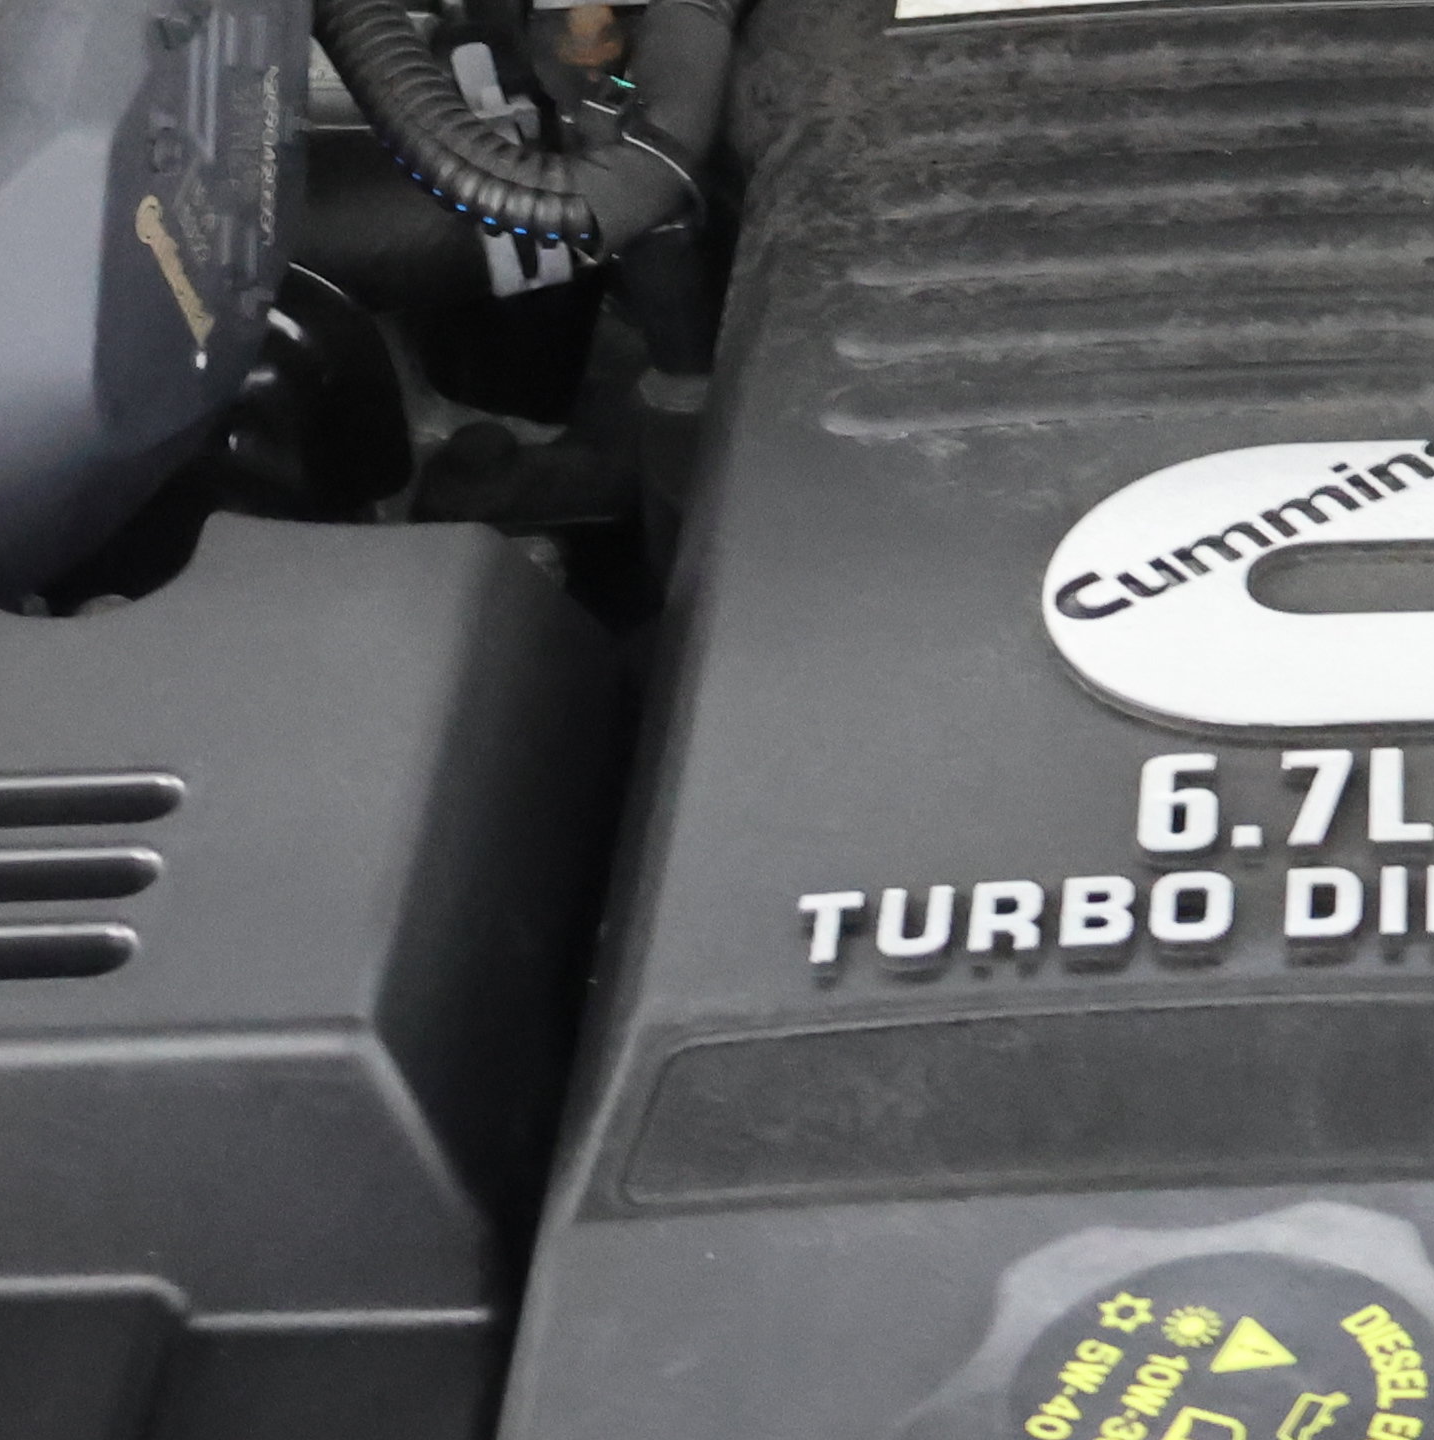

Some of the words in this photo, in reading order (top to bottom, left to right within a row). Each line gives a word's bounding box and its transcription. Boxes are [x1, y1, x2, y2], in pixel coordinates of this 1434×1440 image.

[1137, 749, 1434, 853] 6.7L
[799, 871, 1234, 963] TURBO
[1026, 1339, 1123, 1440] 5W-40
[1341, 1305, 1428, 1409] DIESEL
